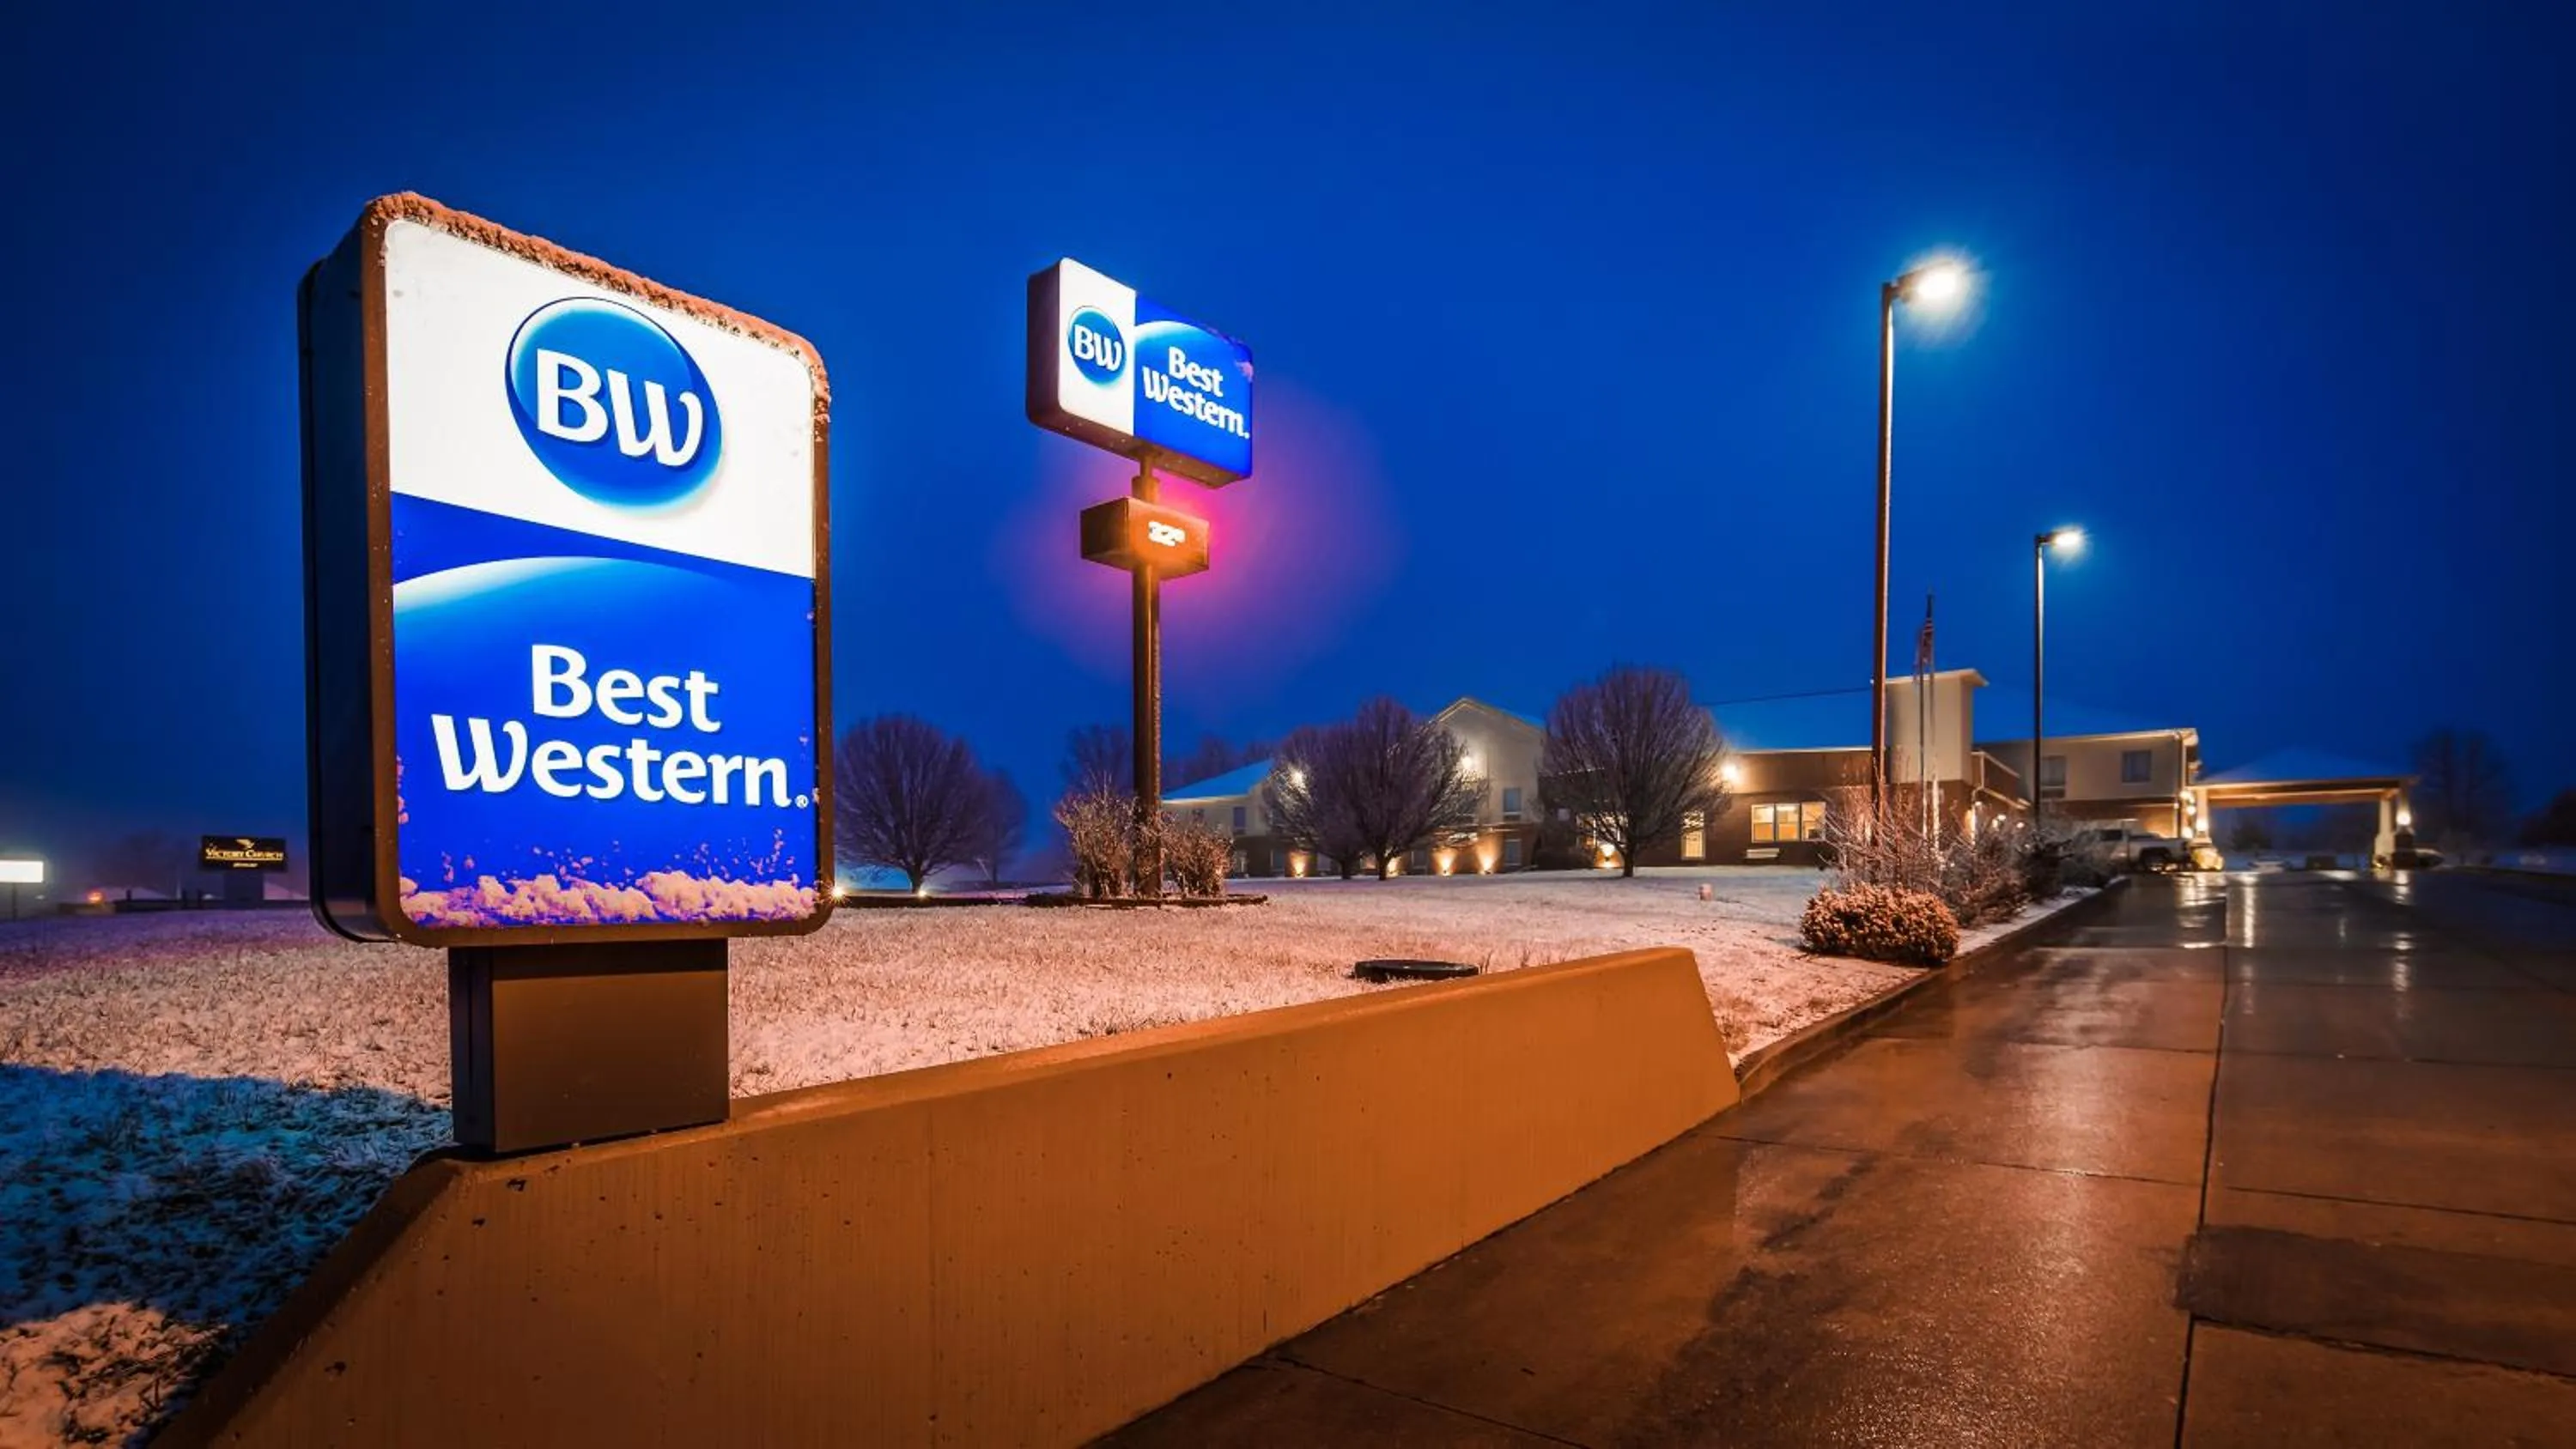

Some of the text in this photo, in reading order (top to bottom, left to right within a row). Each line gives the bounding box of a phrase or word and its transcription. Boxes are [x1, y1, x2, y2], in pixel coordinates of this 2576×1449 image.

[1073, 324, 1122, 371] BW
[1169, 346, 1224, 397] Best
[538, 349, 703, 465] BW
[532, 644, 721, 732] Best
